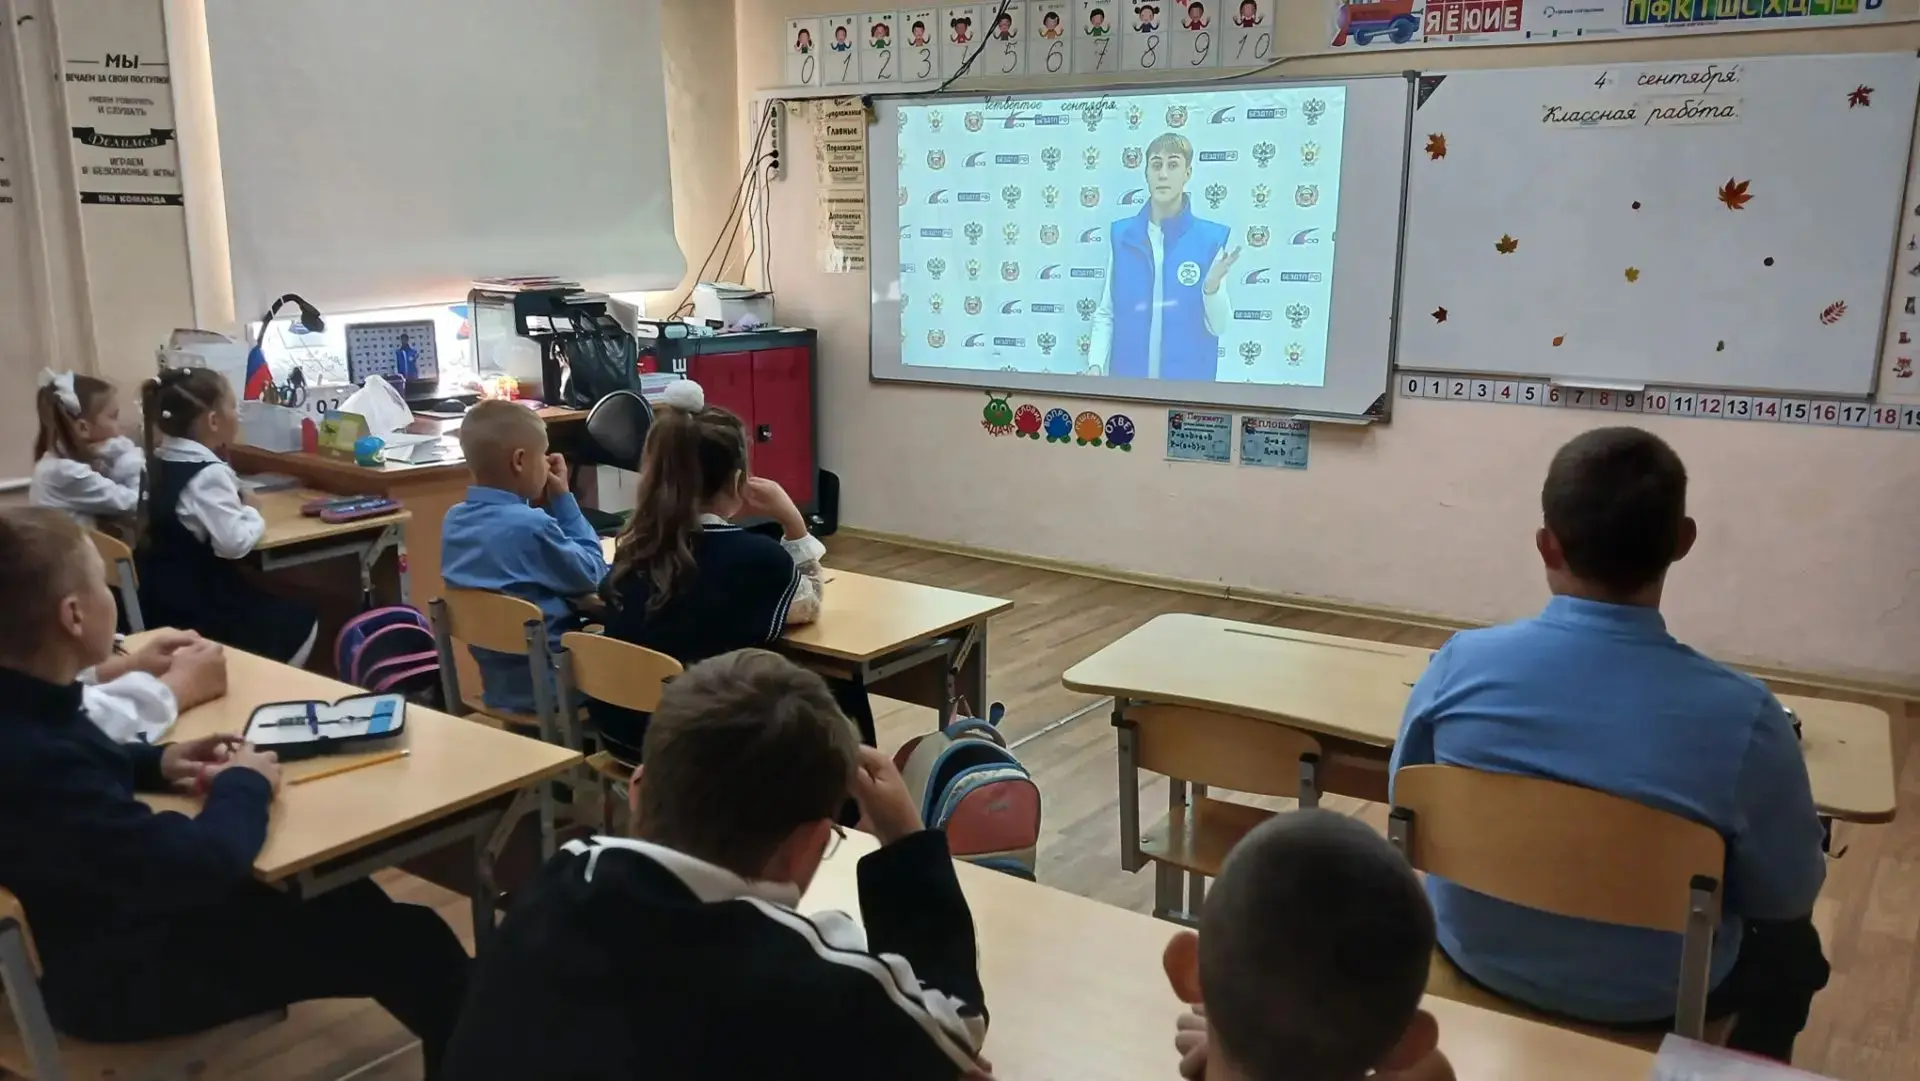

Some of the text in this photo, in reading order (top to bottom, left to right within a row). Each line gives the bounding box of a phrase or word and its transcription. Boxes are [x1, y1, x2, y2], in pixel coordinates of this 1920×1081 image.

[105, 53, 139, 69] МЫ
[801, 55, 815, 84] 0
[841, 52, 852, 82] 1
[877, 50, 891, 80] 2
[917, 48, 932, 78] 3
[1001, 42, 1018, 73] 5
[1046, 40, 1063, 72] 6
[1094, 38, 1110, 70] 7
[1140, 34, 1160, 68] 8
[1190, 31, 1211, 66] 9
[1236, 32, 1271, 60] 10
[1594, 71, 1608, 89] 4
[1542, 105, 1636, 123] Классная
[826, 126, 858, 136] Главные
[316, 398, 339, 414] 07
[1408, 380, 1418, 392] 0
[1432, 381, 1440, 394] 1
[1454, 382, 1464, 396] 2
[1478, 384, 1487, 397] 3
[1501, 385, 1510, 399] 4
[1525, 387, 1535, 400] 5
[1550, 388, 1560, 402] 6
[1575, 390, 1585, 404] 7
[1600, 391, 1609, 406] 8
[1625, 394, 1635, 408] 9
[1646, 395, 1666, 410] 10
[1674, 397, 1692, 411] 11
[1700, 398, 1720, 414] 12
[1728, 400, 1748, 415] 13
[1755, 402, 1776, 417] 14
[1784, 404, 1806, 418] 15
[1813, 405, 1836, 420] 16
[1843, 407, 1866, 422] 17
[1874, 408, 1897, 424] 18
[1044, 410, 1072, 428] ВОПРОС
[1105, 416, 1135, 435] ОТВЕТ
